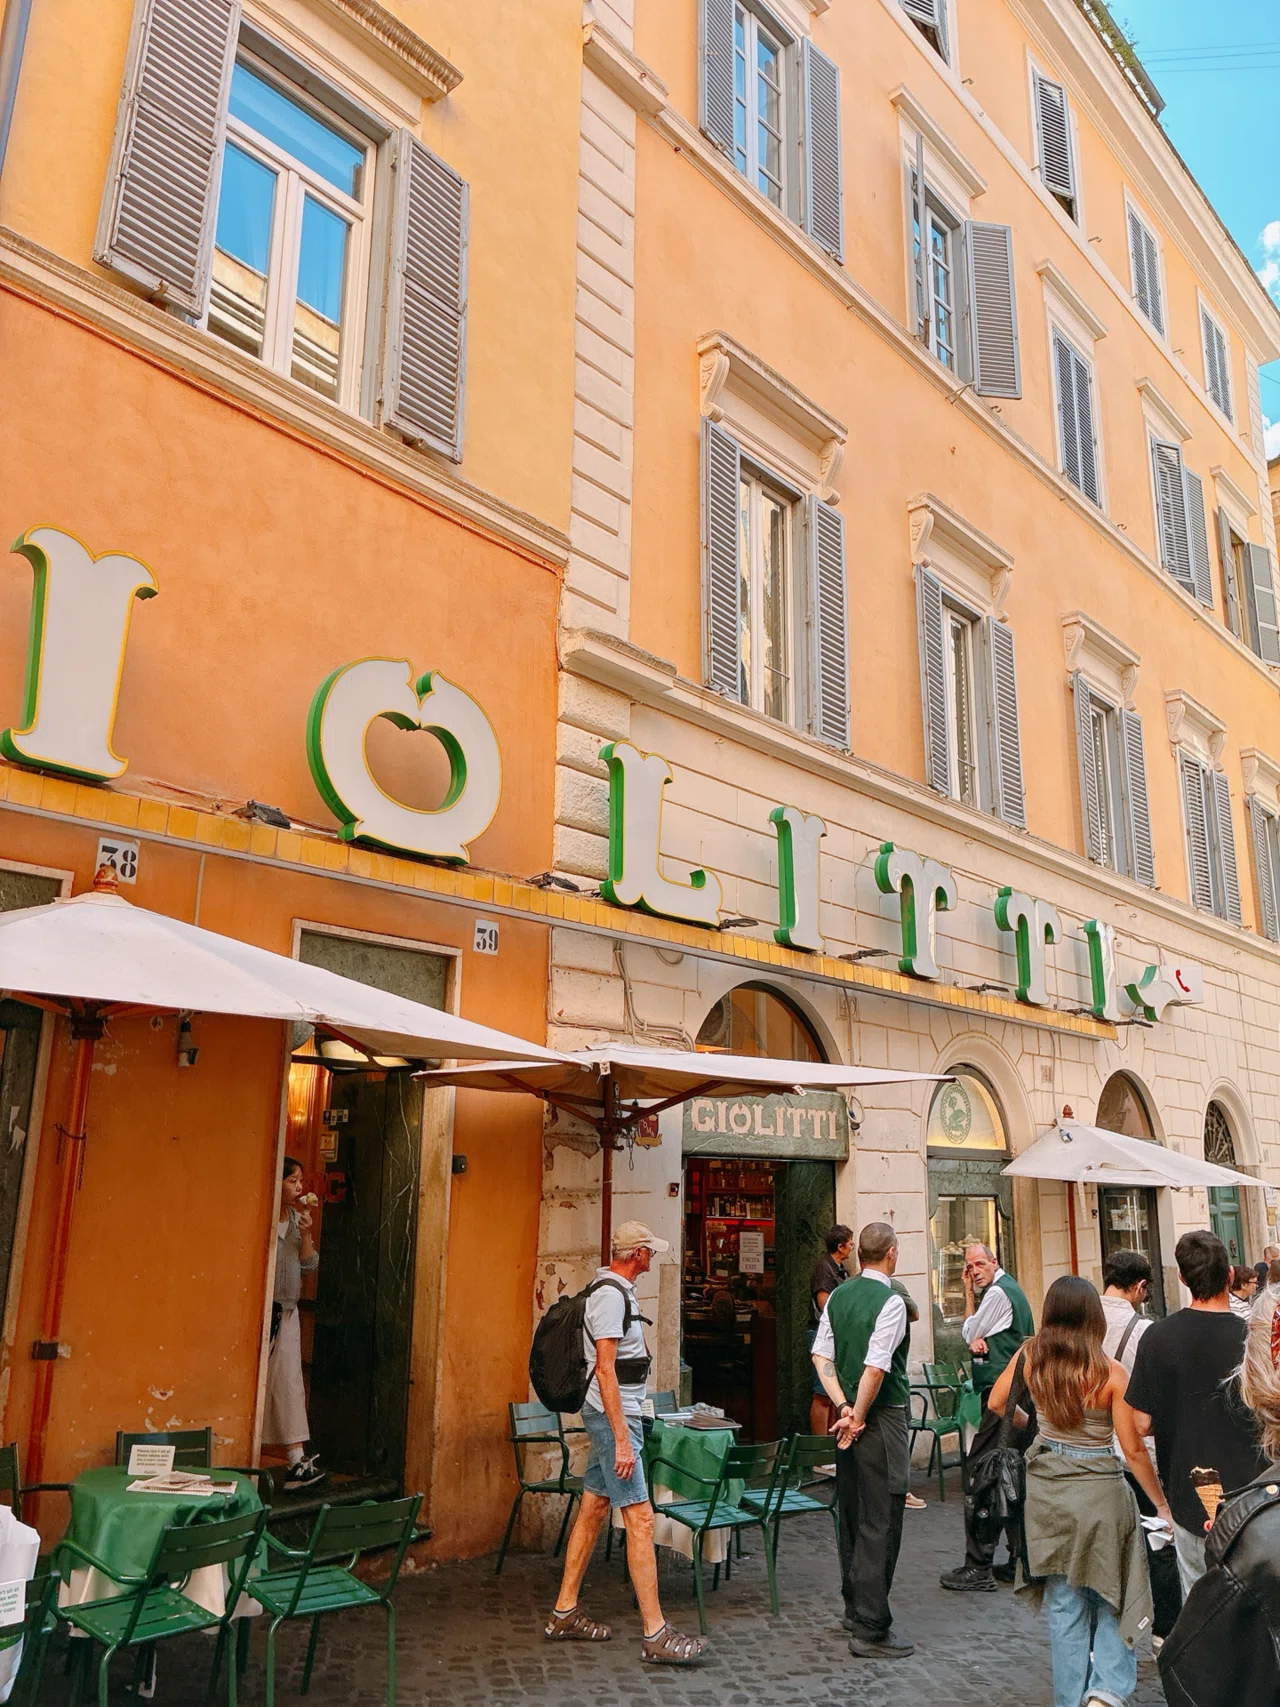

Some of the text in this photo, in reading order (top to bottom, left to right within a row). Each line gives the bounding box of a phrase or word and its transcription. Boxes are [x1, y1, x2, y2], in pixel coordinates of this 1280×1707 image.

[100, 845, 136, 878] 38
[476, 927, 498, 951] 39
[691, 1098, 837, 1140] GIOLITTI
